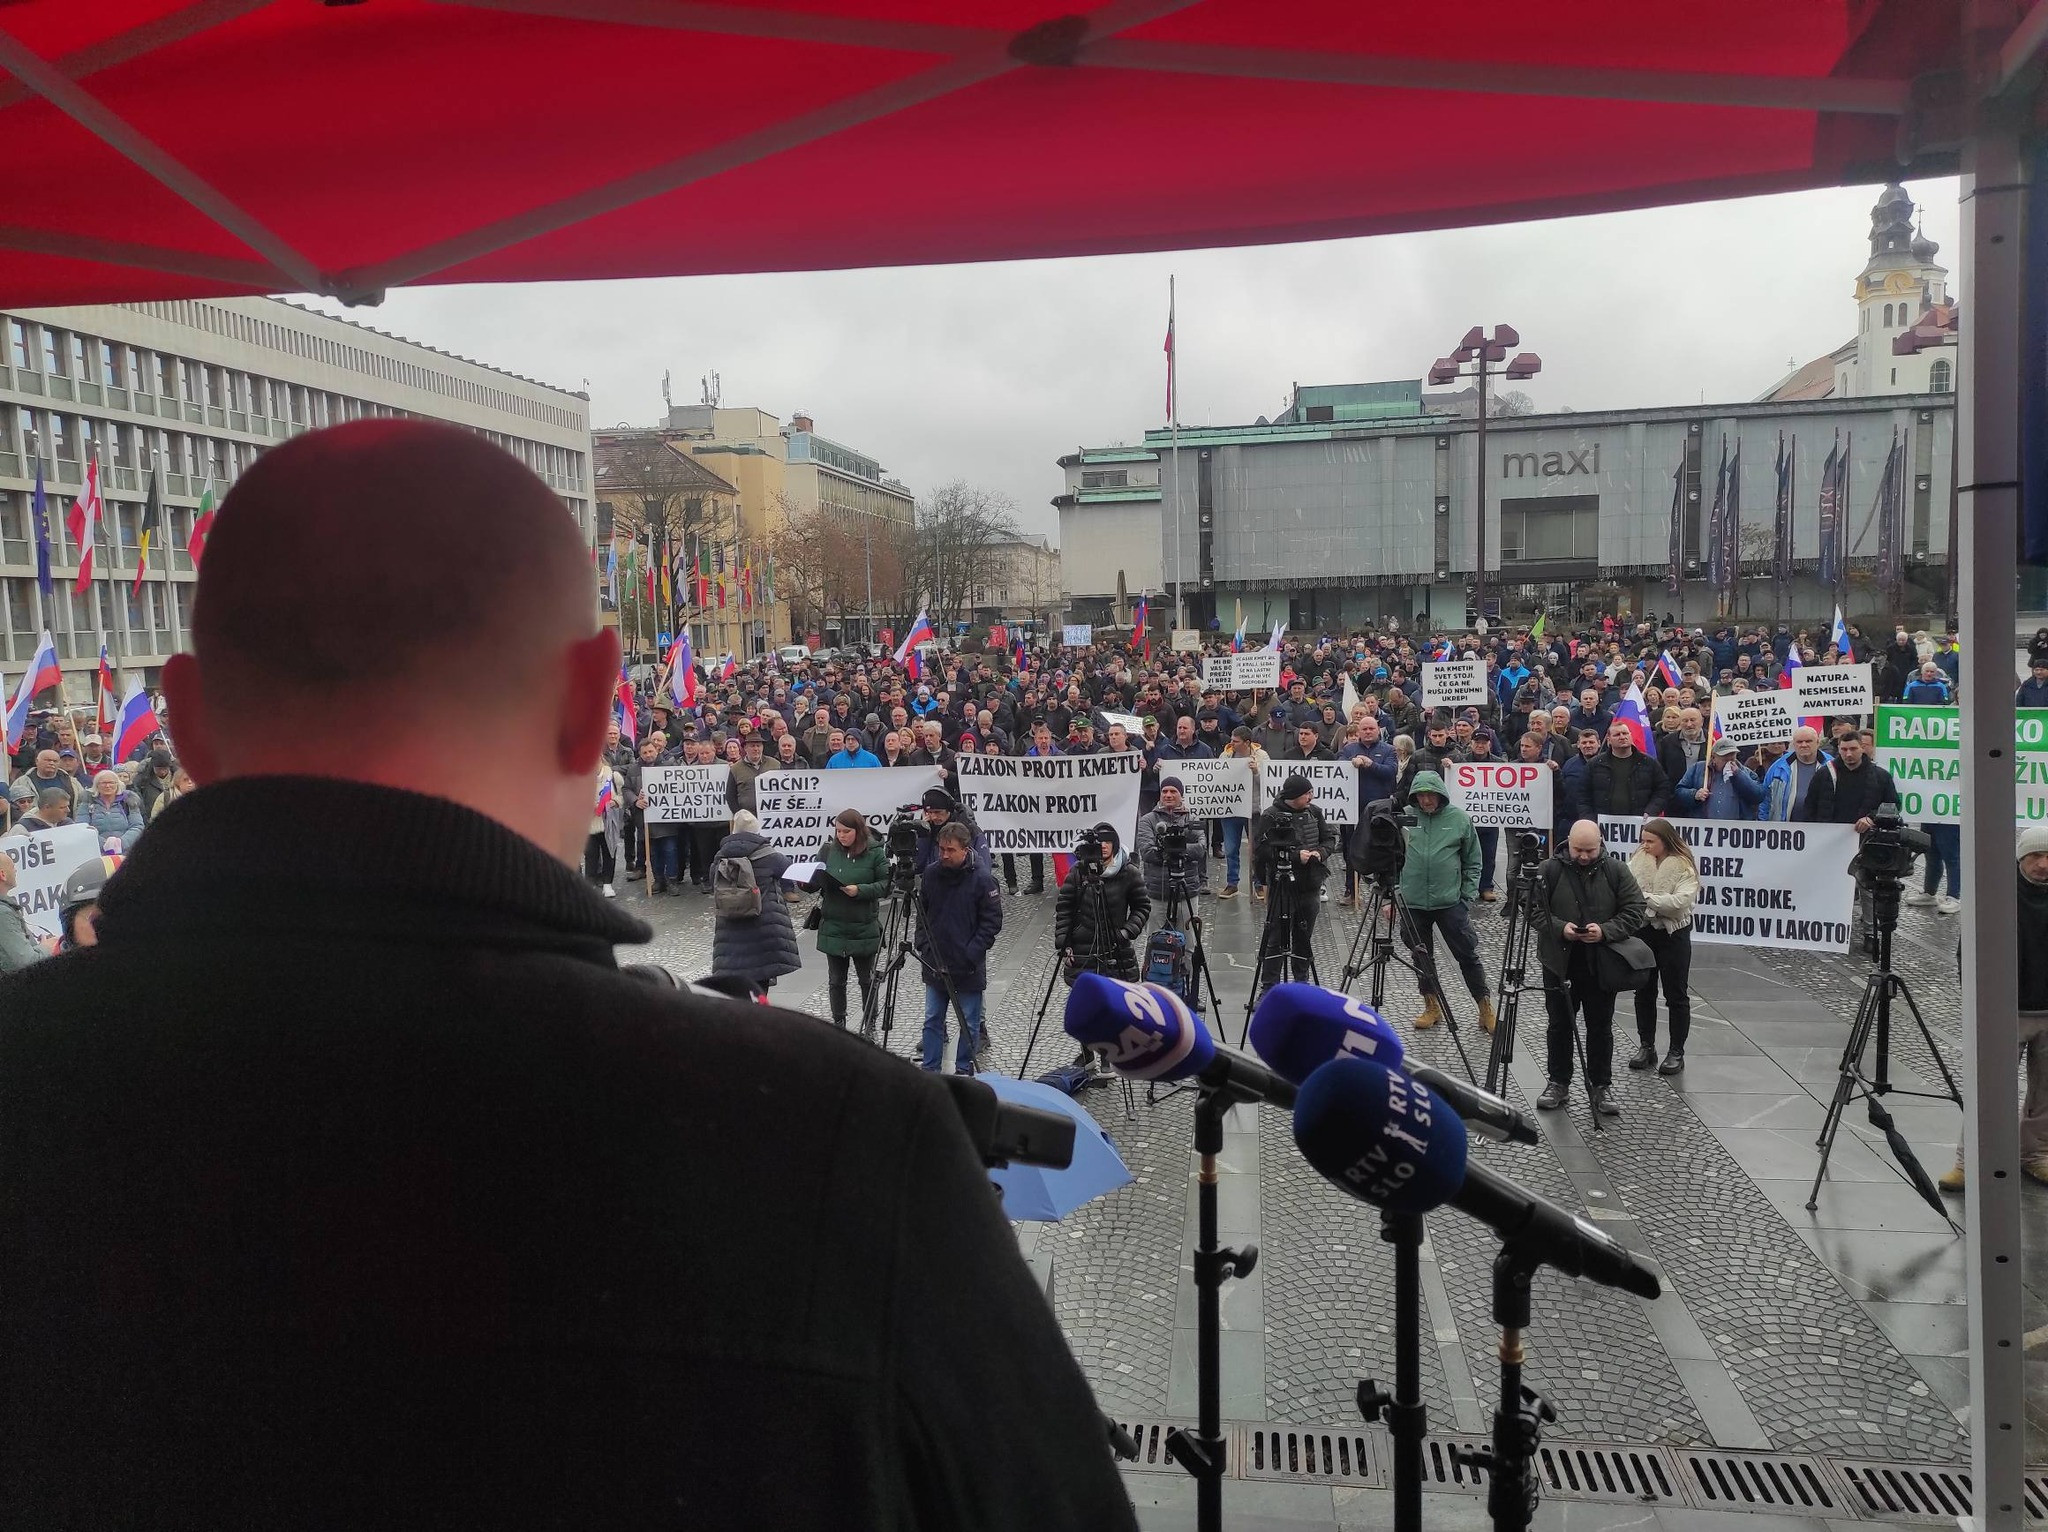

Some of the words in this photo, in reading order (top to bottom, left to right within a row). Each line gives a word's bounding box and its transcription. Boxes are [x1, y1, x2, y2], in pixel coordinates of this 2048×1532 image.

[1503, 443, 1600, 478] maxi
[1807, 673, 1849, 683] NATURA
[1799, 685, 1866, 696] NESMISELNA
[1737, 697, 1776, 709] ZELENI
[1803, 698, 1863, 708] AVANTURA!
[1727, 708, 1768, 721] UKREPI
[1771, 707, 1787, 716] ZA
[1724, 717, 1792, 732] ZARAŠČENO
[961, 756, 1016, 777] ZAKON
[1021, 759, 1074, 779] PROTI
[1079, 754, 1141, 777] KMETU
[1181, 761, 1230, 771] PRAVICA
[1267, 765, 1282, 777] NI
[1288, 765, 1349, 780] KMETA,
[664, 769, 709, 781] PROTI
[760, 773, 820, 791] LAČNI?
[1197, 773, 1214, 782] DO
[1458, 766, 1539, 788] STOP
[647, 781, 726, 794] OMEJITVAM
[1185, 783, 1245, 794] ETOVANJA
[648, 796, 669, 807] NA
[674, 794, 726, 807] LASTNI
[760, 798, 782, 811] NE
[786, 795, 823, 810] ŠE...!
[983, 793, 1040, 813] ZAKON
[1045, 794, 1097, 813] PROTI
[1188, 794, 1242, 806] USTAVNA
[1465, 791, 1530, 801] ZAHTEVAM
[661, 807, 714, 820] ZEMLJI
[1190, 807, 1233, 817] RAVICA
[1465, 803, 1530, 813] ZELENEGA
[761, 816, 822, 829] ZARADI
[1471, 815, 1533, 825] OGOVORA
[984, 828, 1074, 849] TROŠNIKU!
[1704, 827, 1713, 847] Z
[1718, 827, 1805, 851] PODPORO
[1699, 856, 1743, 877] BREZ
[1721, 887, 1796, 911] STROKE,
[1759, 918, 1771, 938] V
[1776, 920, 1850, 944] LAKOTO!
[1386, 1069, 1408, 1115] RTV
[1411, 1081, 1432, 1127] SLO
[1344, 1144, 1389, 1184] RTV
[1370, 1162, 1416, 1198] SLO
